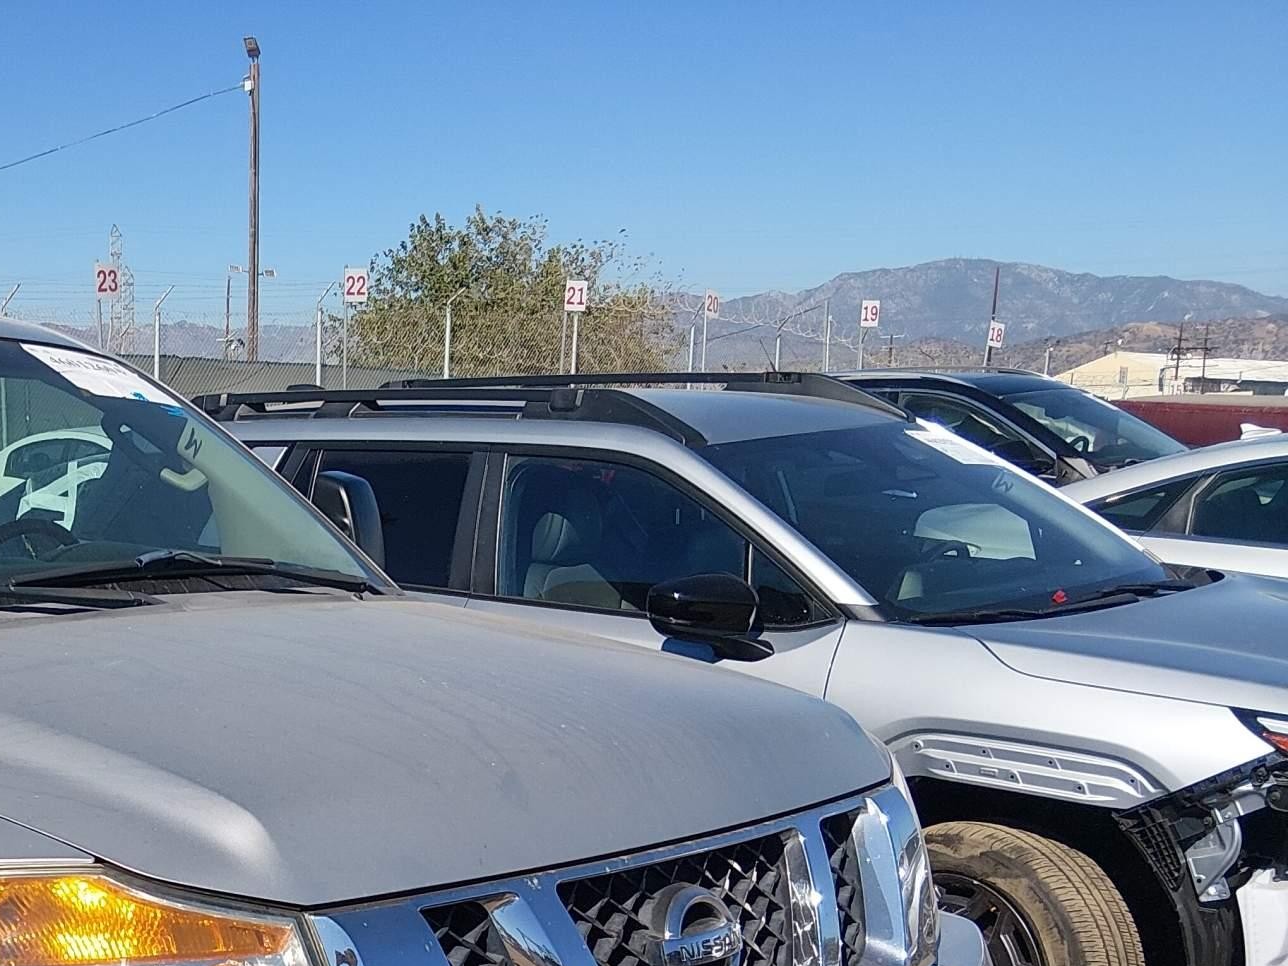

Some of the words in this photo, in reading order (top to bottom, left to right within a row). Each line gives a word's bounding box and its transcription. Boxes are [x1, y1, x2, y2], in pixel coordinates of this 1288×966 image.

[97, 269, 118, 293] 23
[346, 275, 366, 296] 22
[566, 286, 585, 305] 21
[707, 294, 719, 314] 20
[862, 305, 878, 322] 19
[989, 327, 1003, 343] 18
[679, 929, 741, 961] NISSAN
